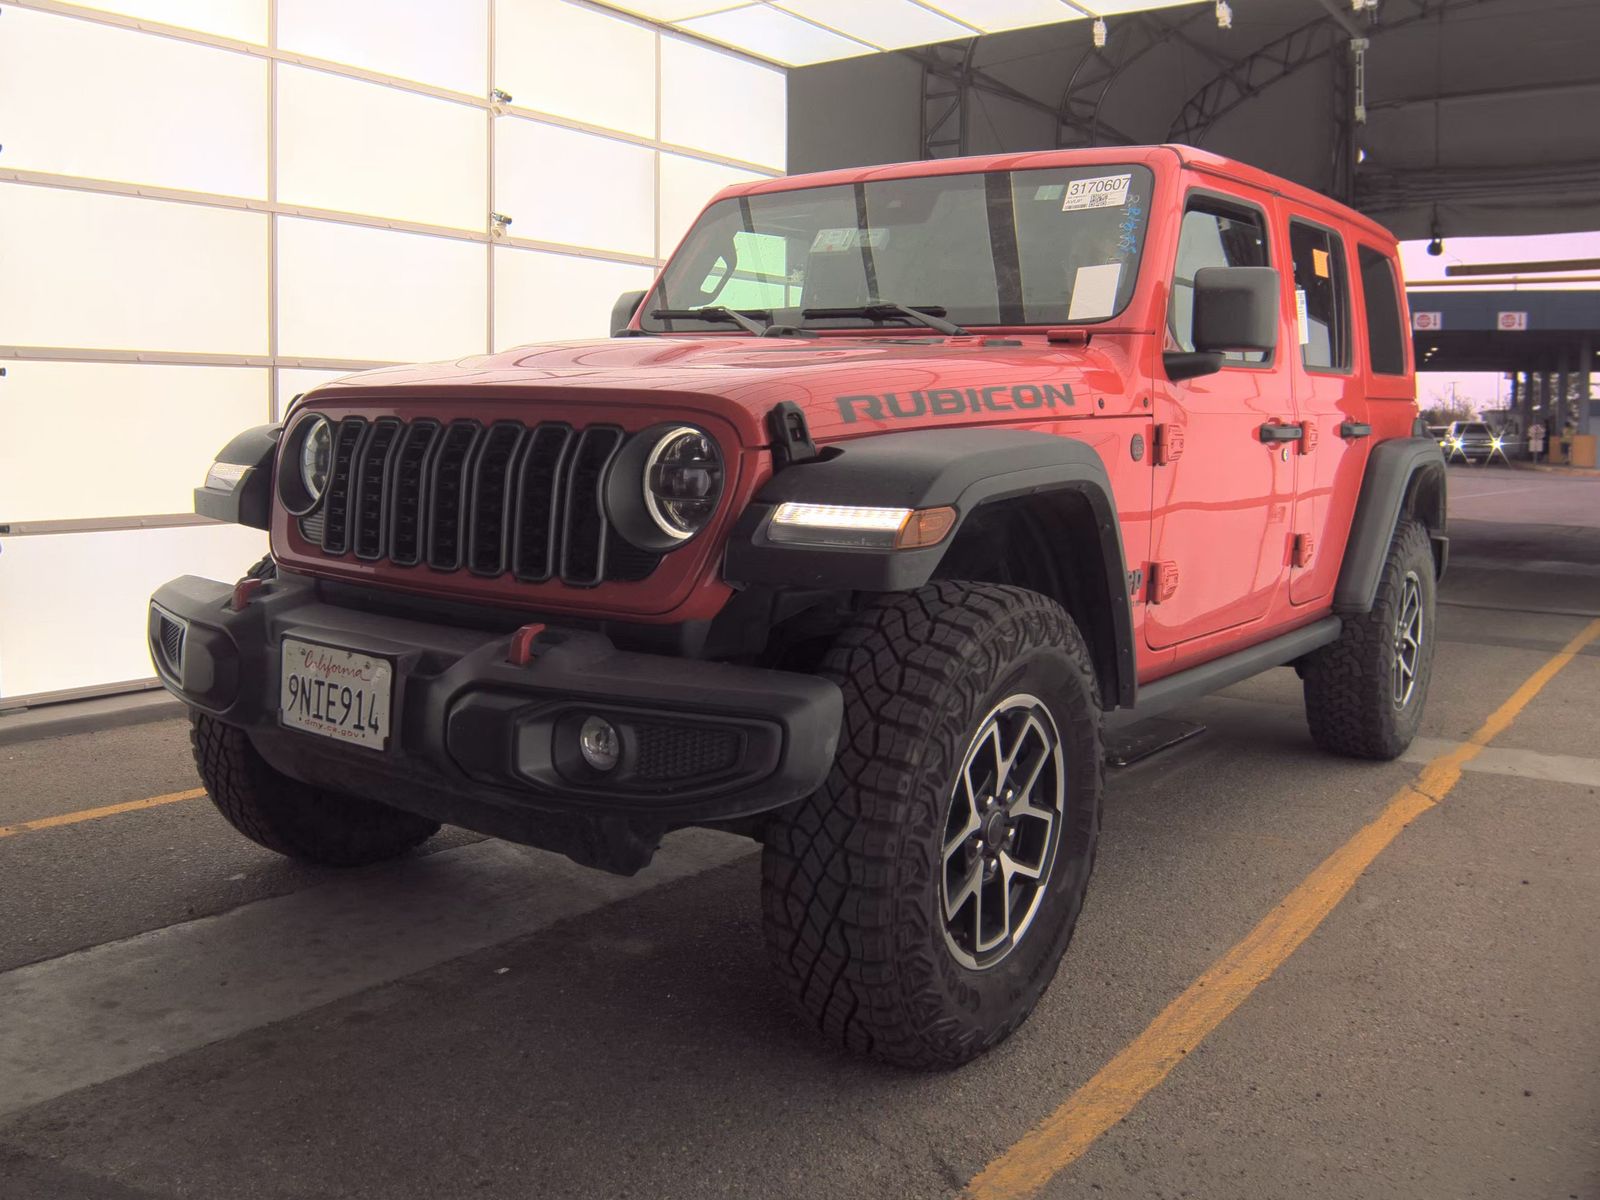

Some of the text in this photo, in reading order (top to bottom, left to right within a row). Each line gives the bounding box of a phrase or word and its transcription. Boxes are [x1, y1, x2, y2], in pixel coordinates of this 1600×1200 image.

[1070, 177, 1131, 196] 3170607
[836, 383, 1076, 424] RUBICON
[304, 649, 371, 682] California
[288, 674, 379, 736] 9NIE914
